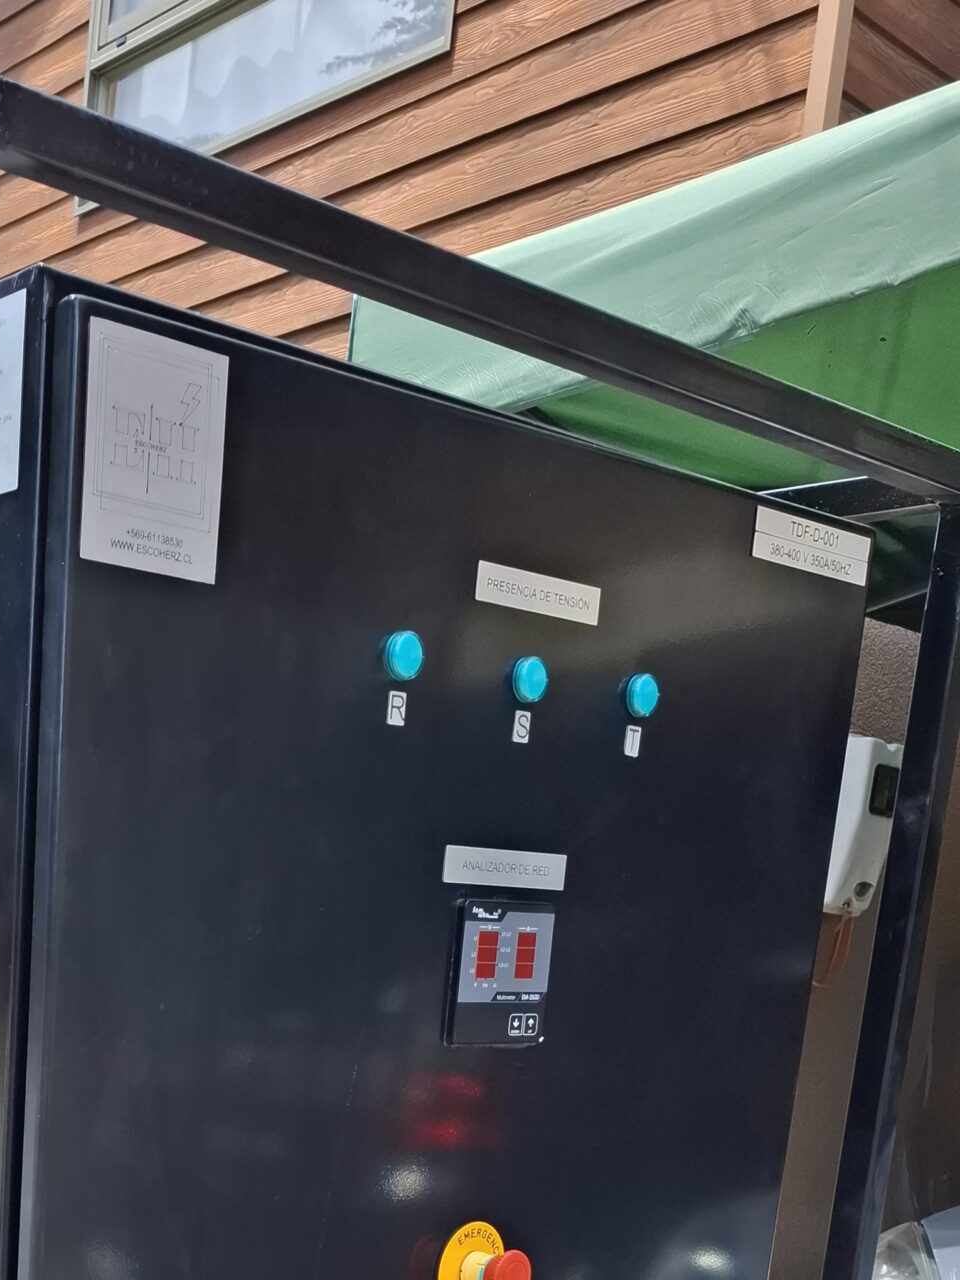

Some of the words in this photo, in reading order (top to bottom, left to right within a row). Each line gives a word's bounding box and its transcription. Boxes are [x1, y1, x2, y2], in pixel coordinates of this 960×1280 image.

[126, 528, 184, 548] +569-61138530
[790, 520, 840, 548] TDF-D-001
[110, 538, 193, 565] WWW.ESCOHERZ.CL
[769, 542, 801, 562] 380-400
[803, 553, 810, 564] V
[810, 553, 852, 576] 350A/50HZ
[486, 577, 537, 600] PRESENCIA
[539, 590, 551, 603] DE
[553, 592, 591, 612] TENSIÓN
[390, 694, 406, 721] R
[516, 714, 530, 739] S
[629, 728, 640, 752] T
[462, 860, 516, 874] ANALIZADOR
[518, 864, 530, 875] DE
[532, 865, 550, 877] RED
